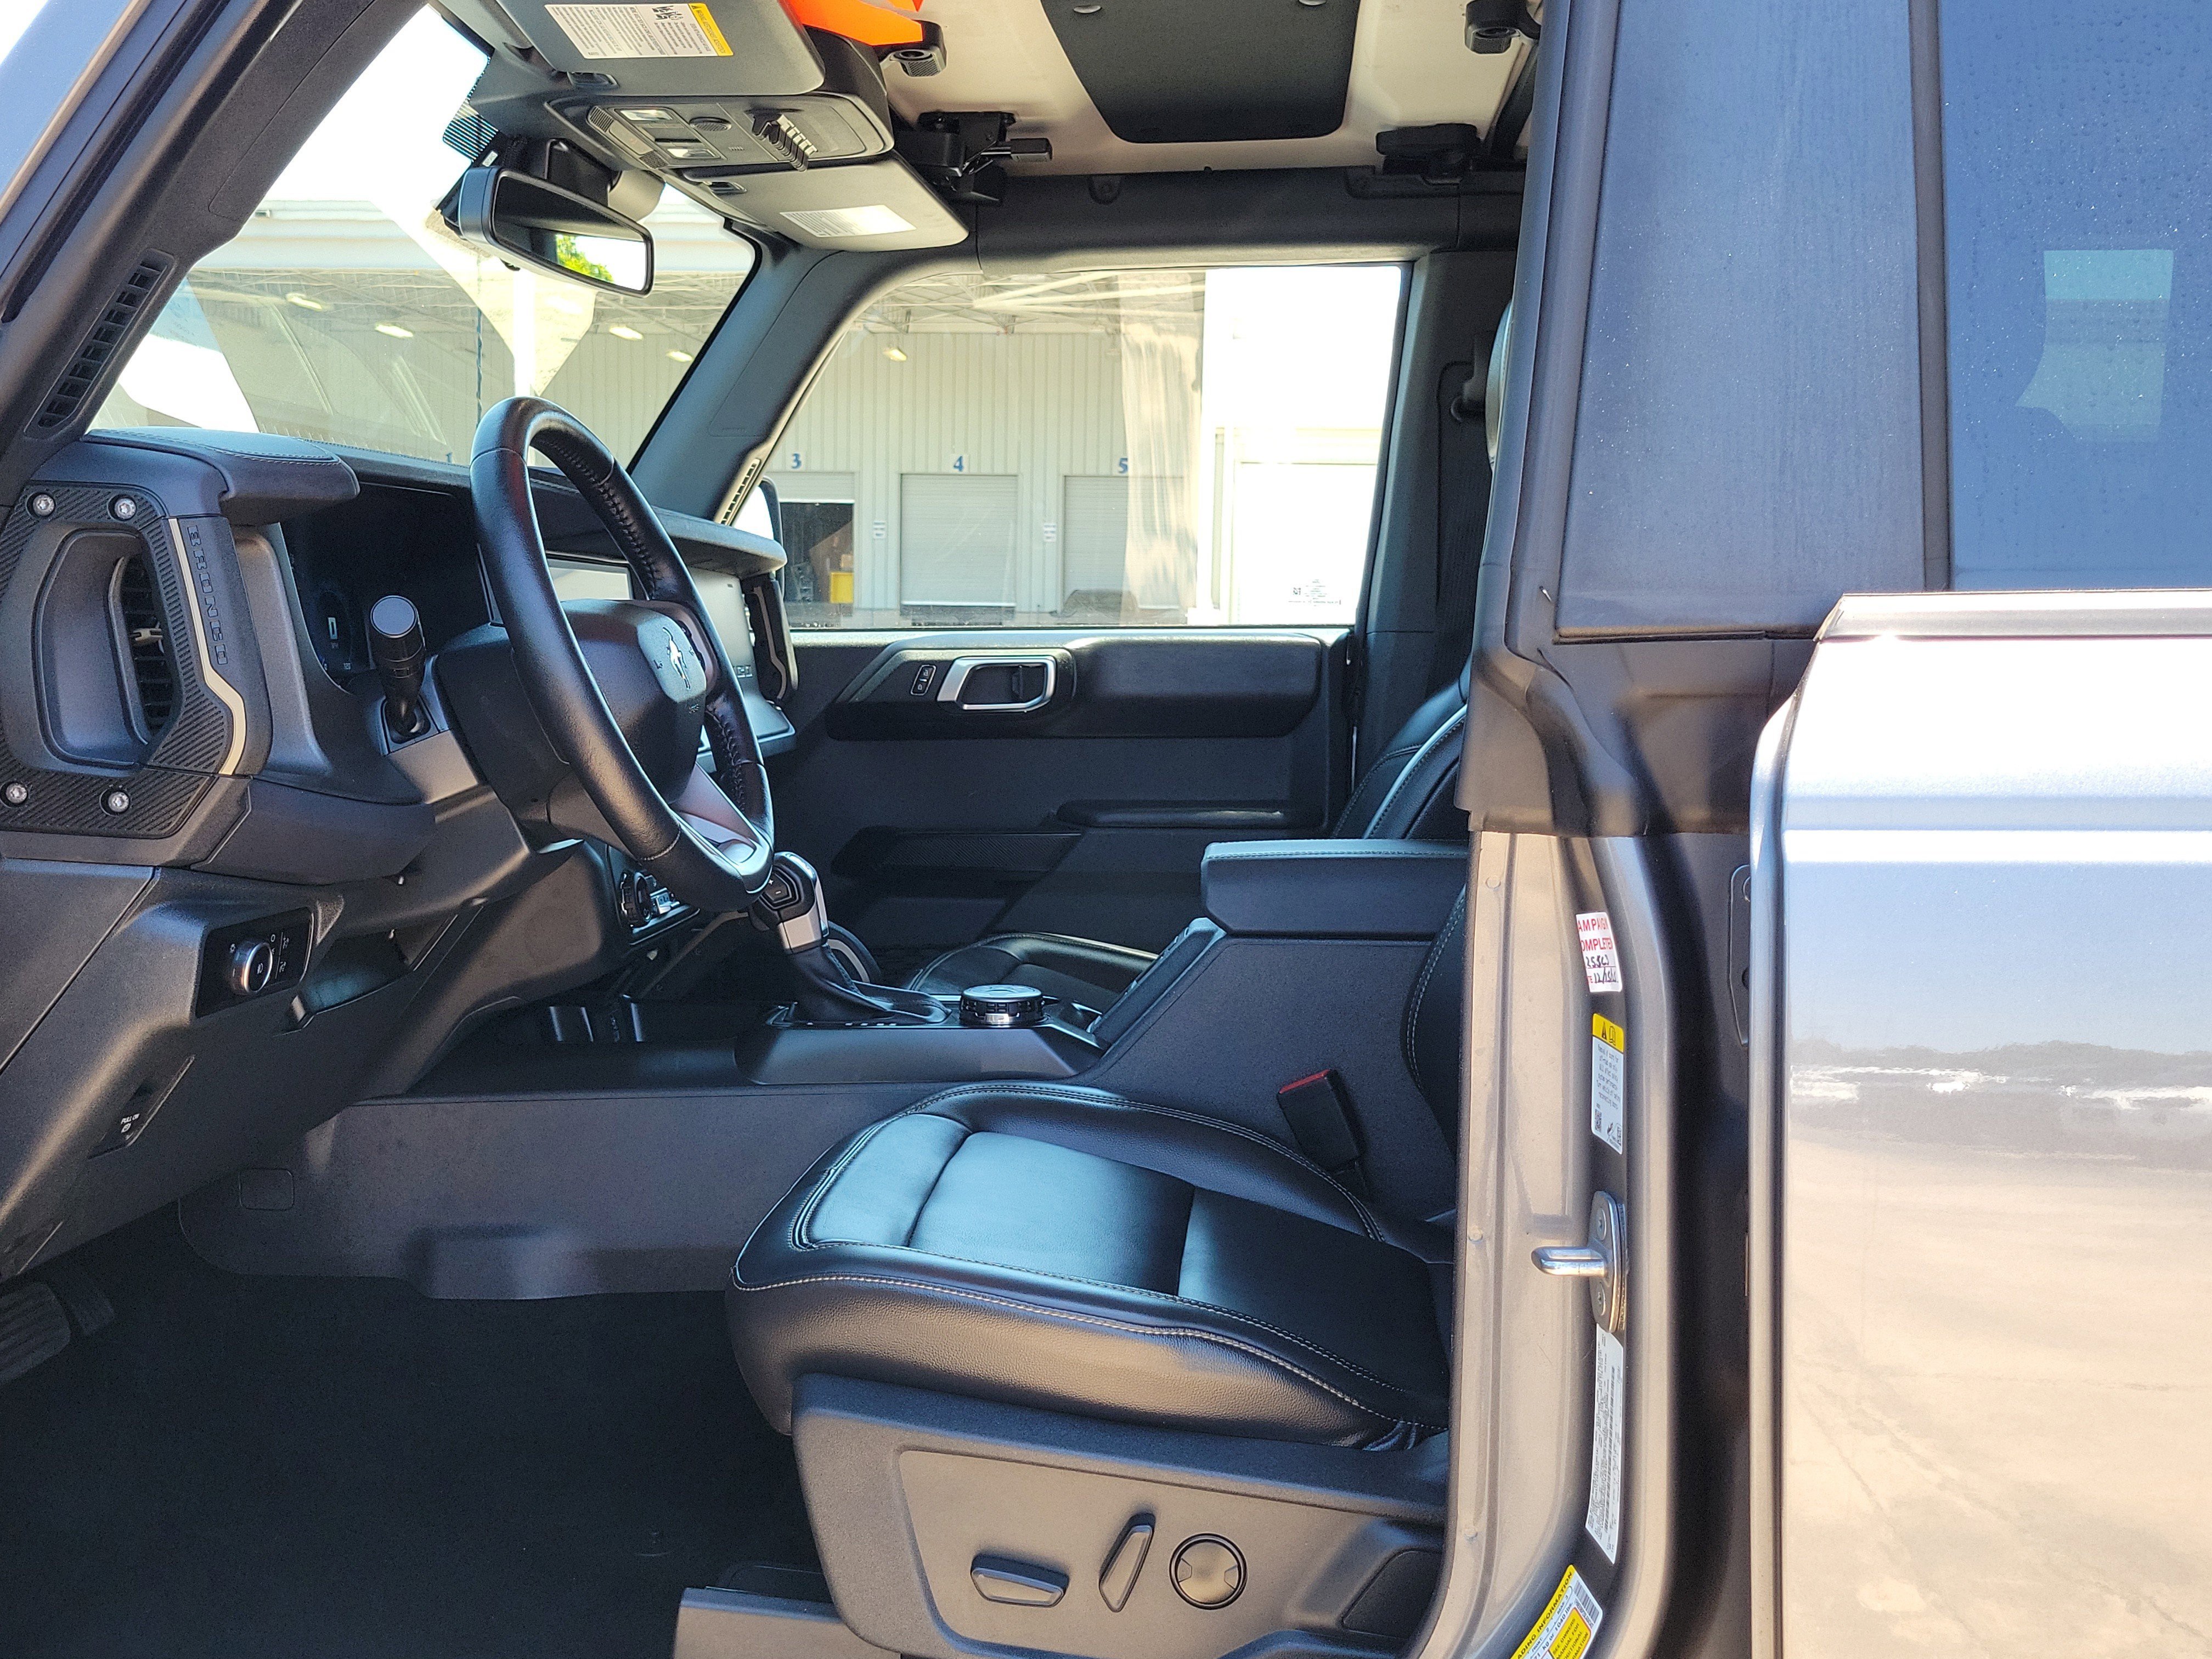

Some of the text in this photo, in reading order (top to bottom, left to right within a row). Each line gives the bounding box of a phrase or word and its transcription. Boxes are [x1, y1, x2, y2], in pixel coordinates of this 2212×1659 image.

[791, 453, 802, 470] 3
[953, 455, 964, 472] 4
[1118, 457, 1128, 474] 5
[187, 524, 228, 665] BRONCO
[1537, 1571, 1573, 1633] INFORMATION
[1542, 1640, 1550, 1651] kg
[1549, 1633, 1555, 1641] or
[1555, 1613, 1566, 1631] 1040
